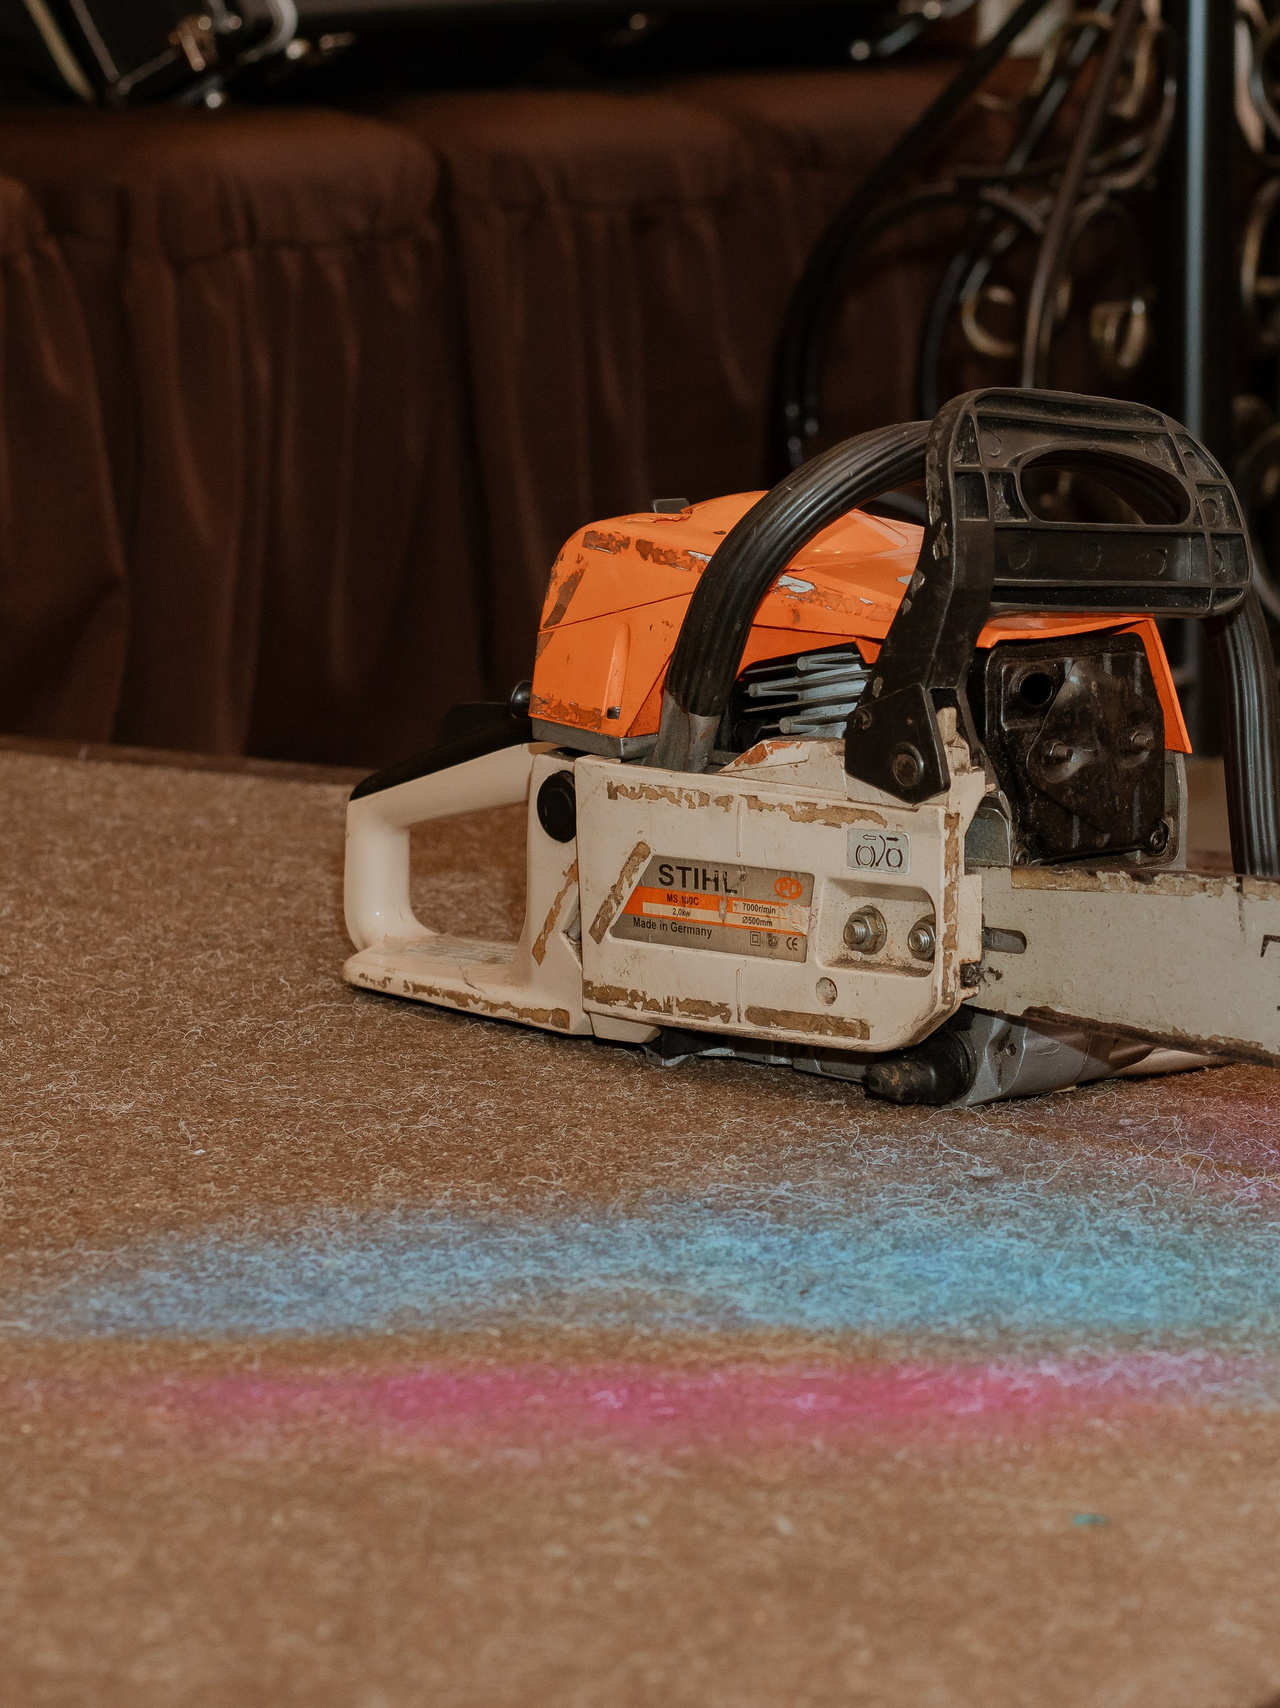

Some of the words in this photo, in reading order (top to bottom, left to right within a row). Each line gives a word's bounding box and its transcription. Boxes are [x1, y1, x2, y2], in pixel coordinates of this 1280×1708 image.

[658, 863, 738, 894] STIHL
[666, 893, 678, 904] MS
[633, 917, 656, 930] Made
[659, 920, 668, 931] in
[670, 922, 713, 939] Germany
